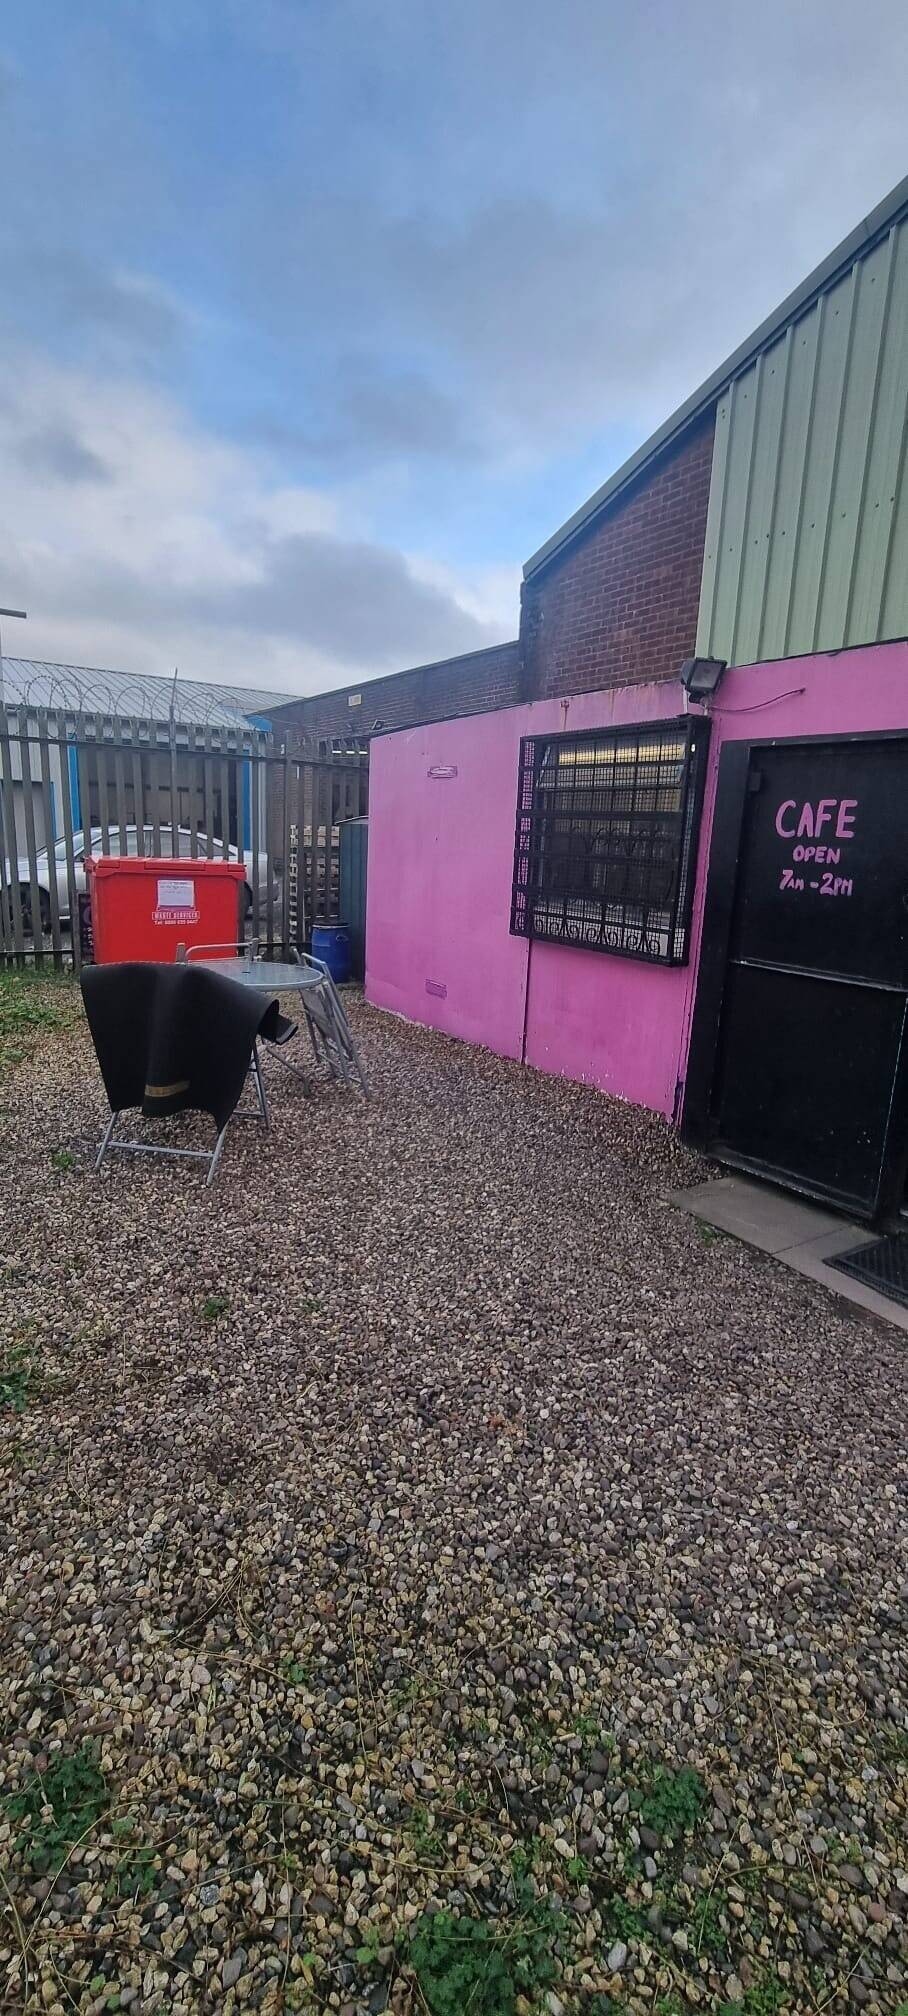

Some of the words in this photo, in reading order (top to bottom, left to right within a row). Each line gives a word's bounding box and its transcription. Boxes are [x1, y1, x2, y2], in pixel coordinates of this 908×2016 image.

[775, 799, 858, 838] CAFE
[793, 845, 840, 864] OPEN
[779, 869, 804, 890] 7AM
